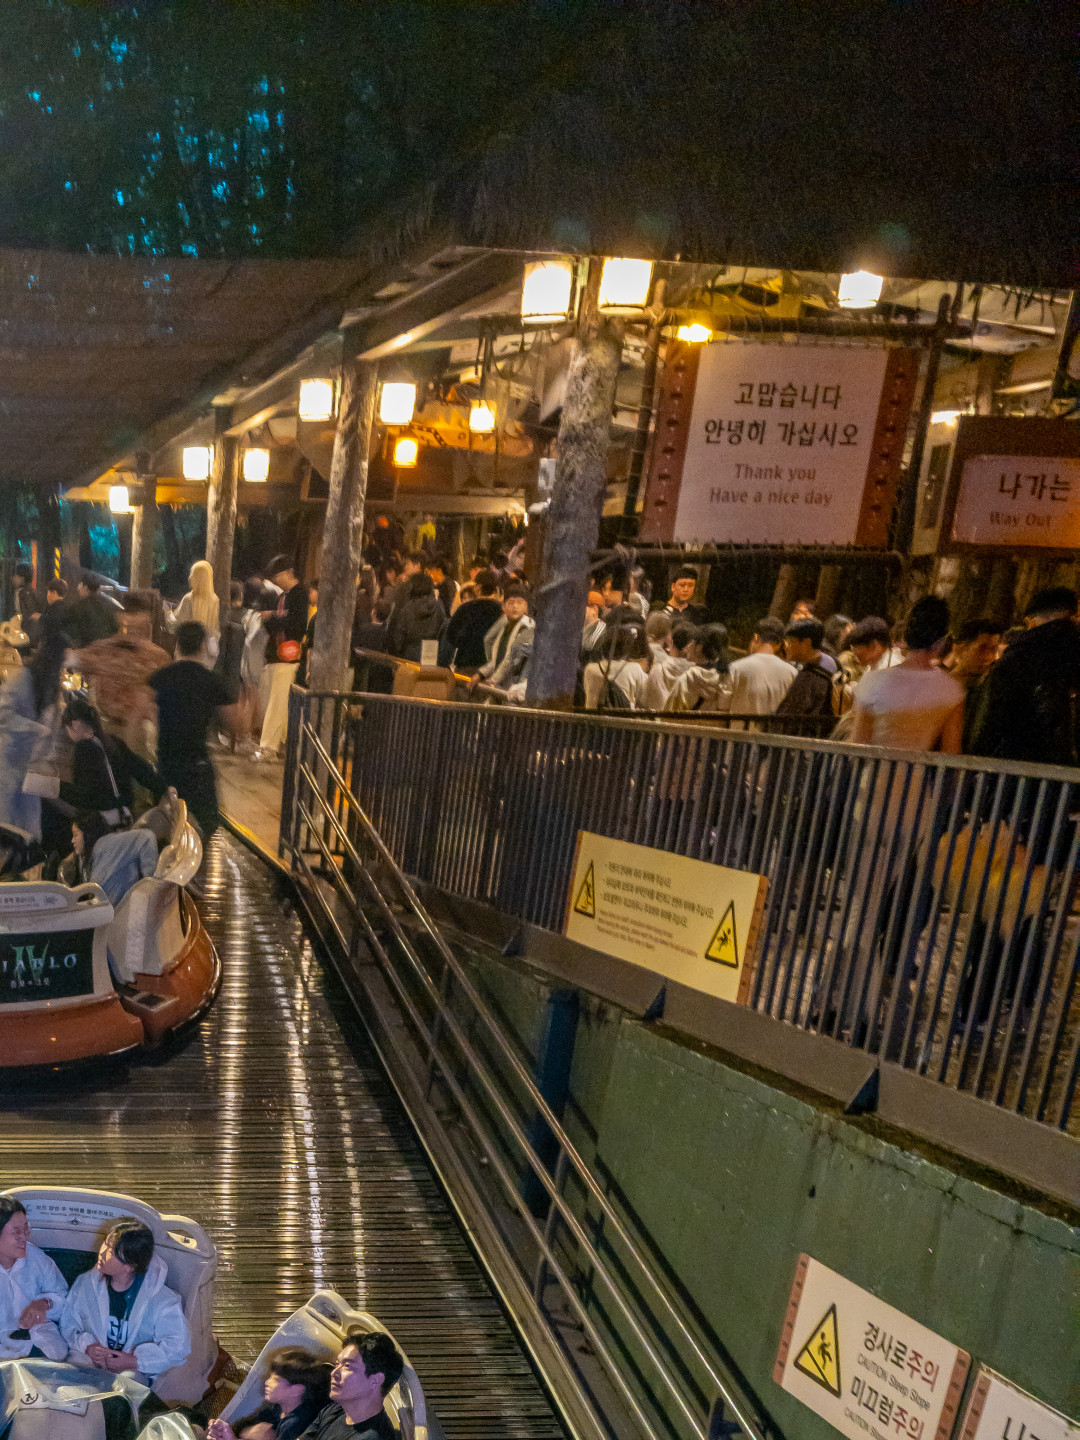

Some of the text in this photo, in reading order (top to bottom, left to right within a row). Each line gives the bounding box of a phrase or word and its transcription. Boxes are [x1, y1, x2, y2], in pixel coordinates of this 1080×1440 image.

[734, 382, 842, 409] 고맙습니다
[705, 419, 859, 447] 안녕히 가십시오
[735, 463, 816, 483] Thank you
[710, 487, 833, 506] Have a nice day
[998, 473, 1071, 502] 나가는
[989, 511, 1019, 527] Way
[856, 1353, 888, 1383] CAUTION
[864, 1320, 940, 1393] 경사로주의
